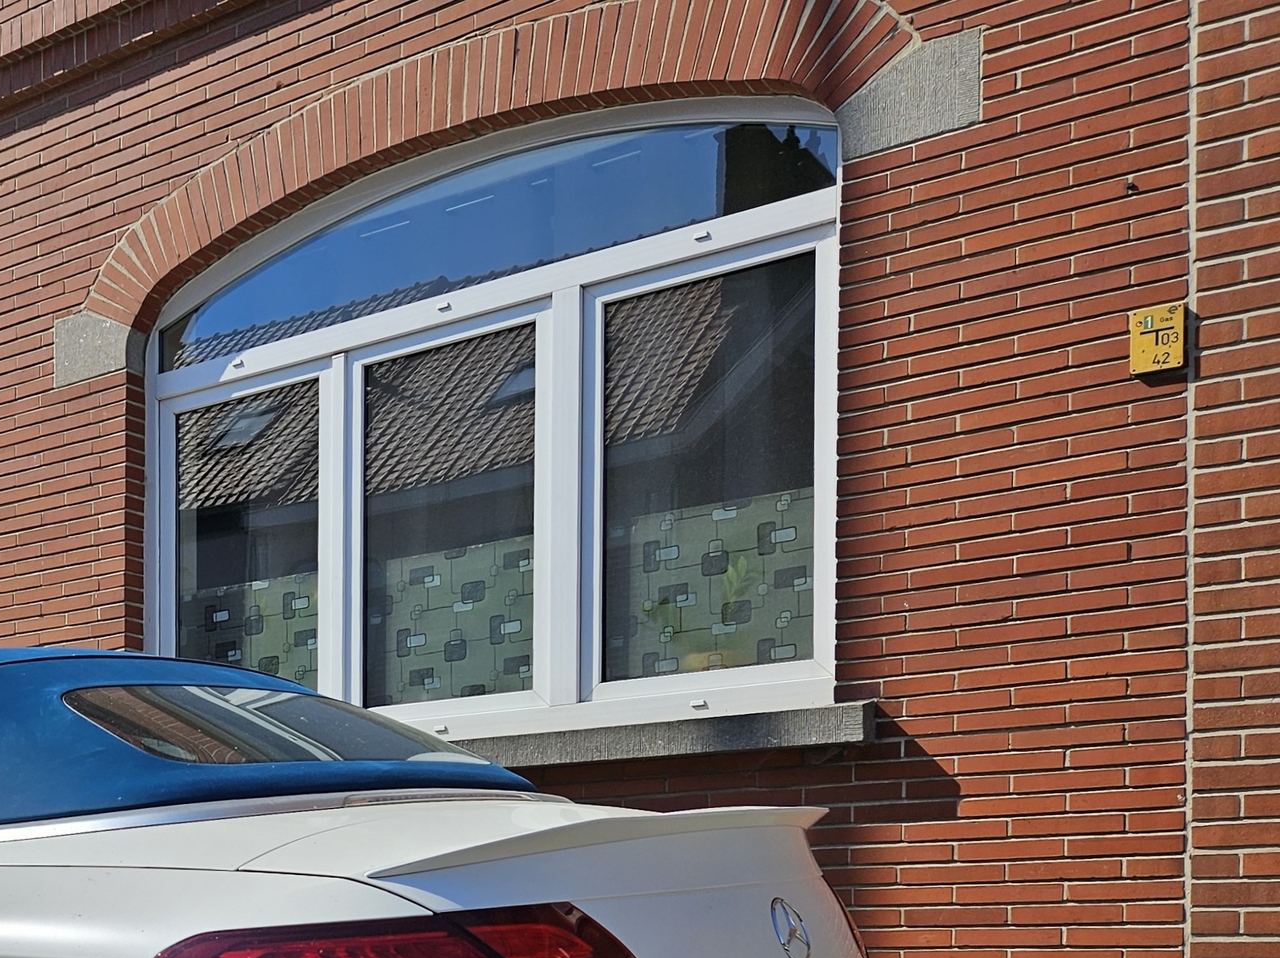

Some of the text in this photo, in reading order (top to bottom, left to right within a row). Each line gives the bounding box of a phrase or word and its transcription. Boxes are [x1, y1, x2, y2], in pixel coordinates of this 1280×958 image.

[1145, 316, 1152, 328] 1
[1161, 332, 1179, 345] 03
[1152, 352, 1170, 365] 42
